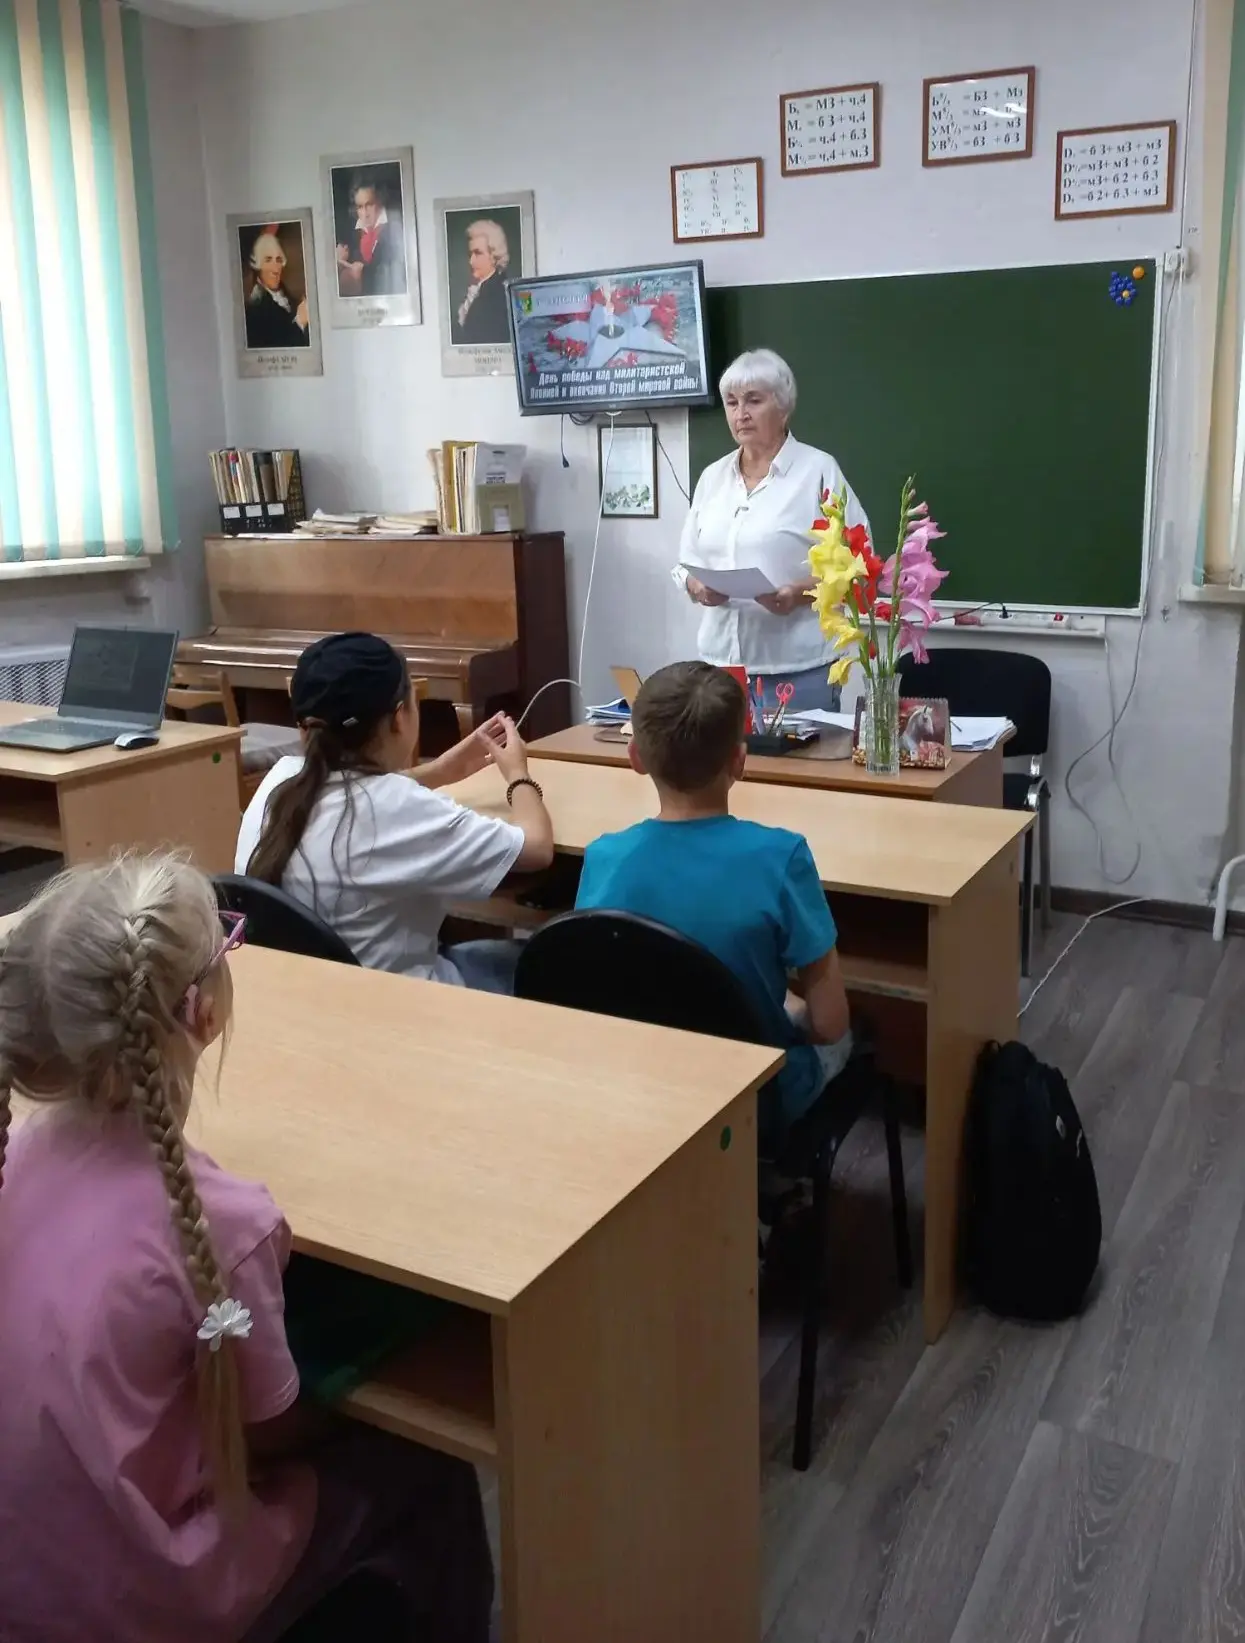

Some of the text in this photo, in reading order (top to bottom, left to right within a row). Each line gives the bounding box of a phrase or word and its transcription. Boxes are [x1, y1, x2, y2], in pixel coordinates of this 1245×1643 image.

[539, 371, 559, 386] День
[562, 370, 592, 384] победы
[596, 370, 610, 381] над
[674, 376, 698, 391] войны
